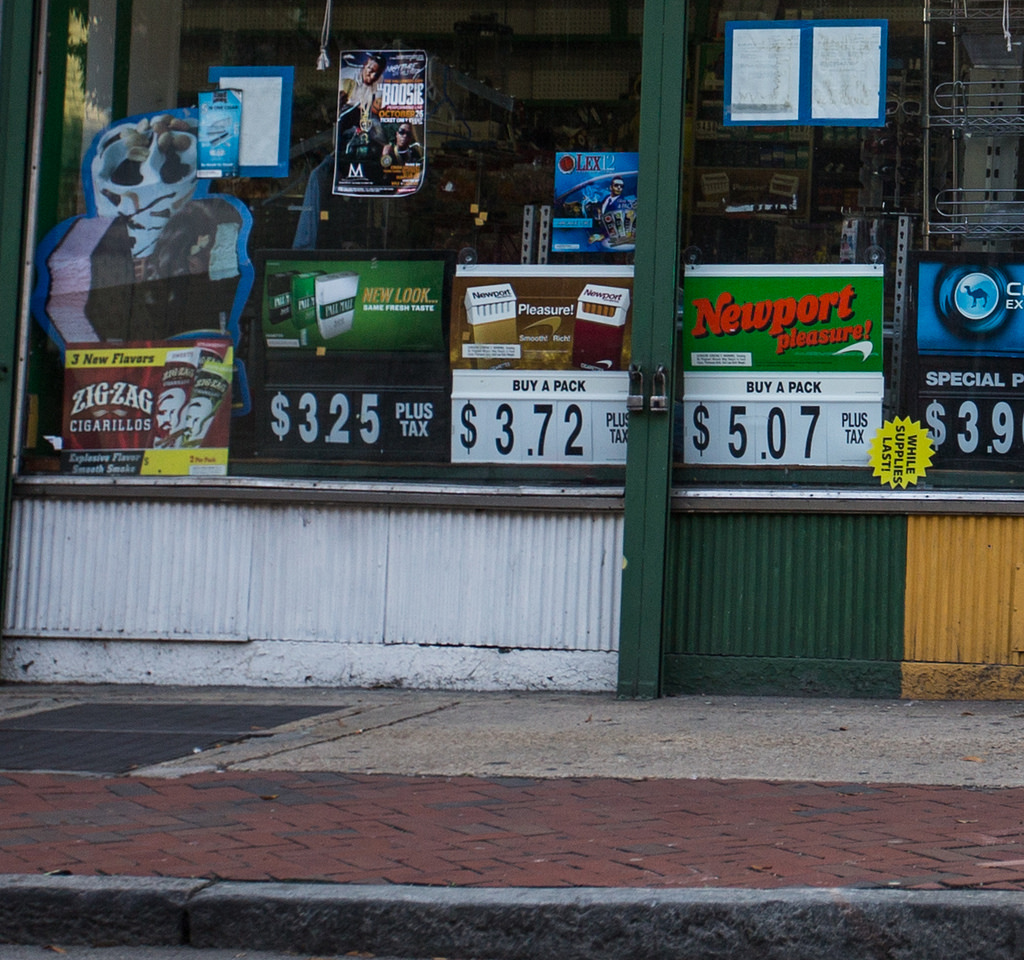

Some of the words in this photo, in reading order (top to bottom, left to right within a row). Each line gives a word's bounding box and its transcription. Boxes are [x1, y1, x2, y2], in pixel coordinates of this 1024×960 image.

[348, 163, 364, 178] M
[362, 287, 390, 303] NEW
[472, 289, 512, 300] Newport
[584, 289, 623, 302] Newport
[363, 304, 384, 312] SAME
[385, 304, 410, 312] FRESH
[411, 304, 435, 312] TASTE
[518, 303, 575, 316] Pleasure!
[691, 284, 857, 338] Newport
[776, 320, 873, 354] pleasure!
[71, 354, 79, 365] 3
[84, 354, 107, 365] New
[112, 352, 155, 365] Flavors
[513, 380, 538, 392] BUY
[541, 380, 550, 392] A
[554, 380, 586, 392] PACK
[746, 381, 773, 394] BUY
[776, 381, 785, 394] A
[789, 381, 822, 394] PACK
[926, 371, 1006, 388] SPECIAL
[71, 381, 154, 416] ZIG-ZAG
[395, 402, 434, 420] PLUS
[70, 418, 152, 432] CIGARILLOS
[606, 412, 630, 428] PLUS
[841, 412, 868, 428] PLUS
[400, 420, 429, 437] TAX
[609, 428, 628, 444] TAX
[845, 429, 864, 444] TAX
[69, 452, 110, 462] Explosive
[112, 452, 141, 462] Flavor
[881, 436, 892, 472] LAST!
[893, 425, 905, 484] SUPPLIES
[905, 434, 918, 475] WHILE
